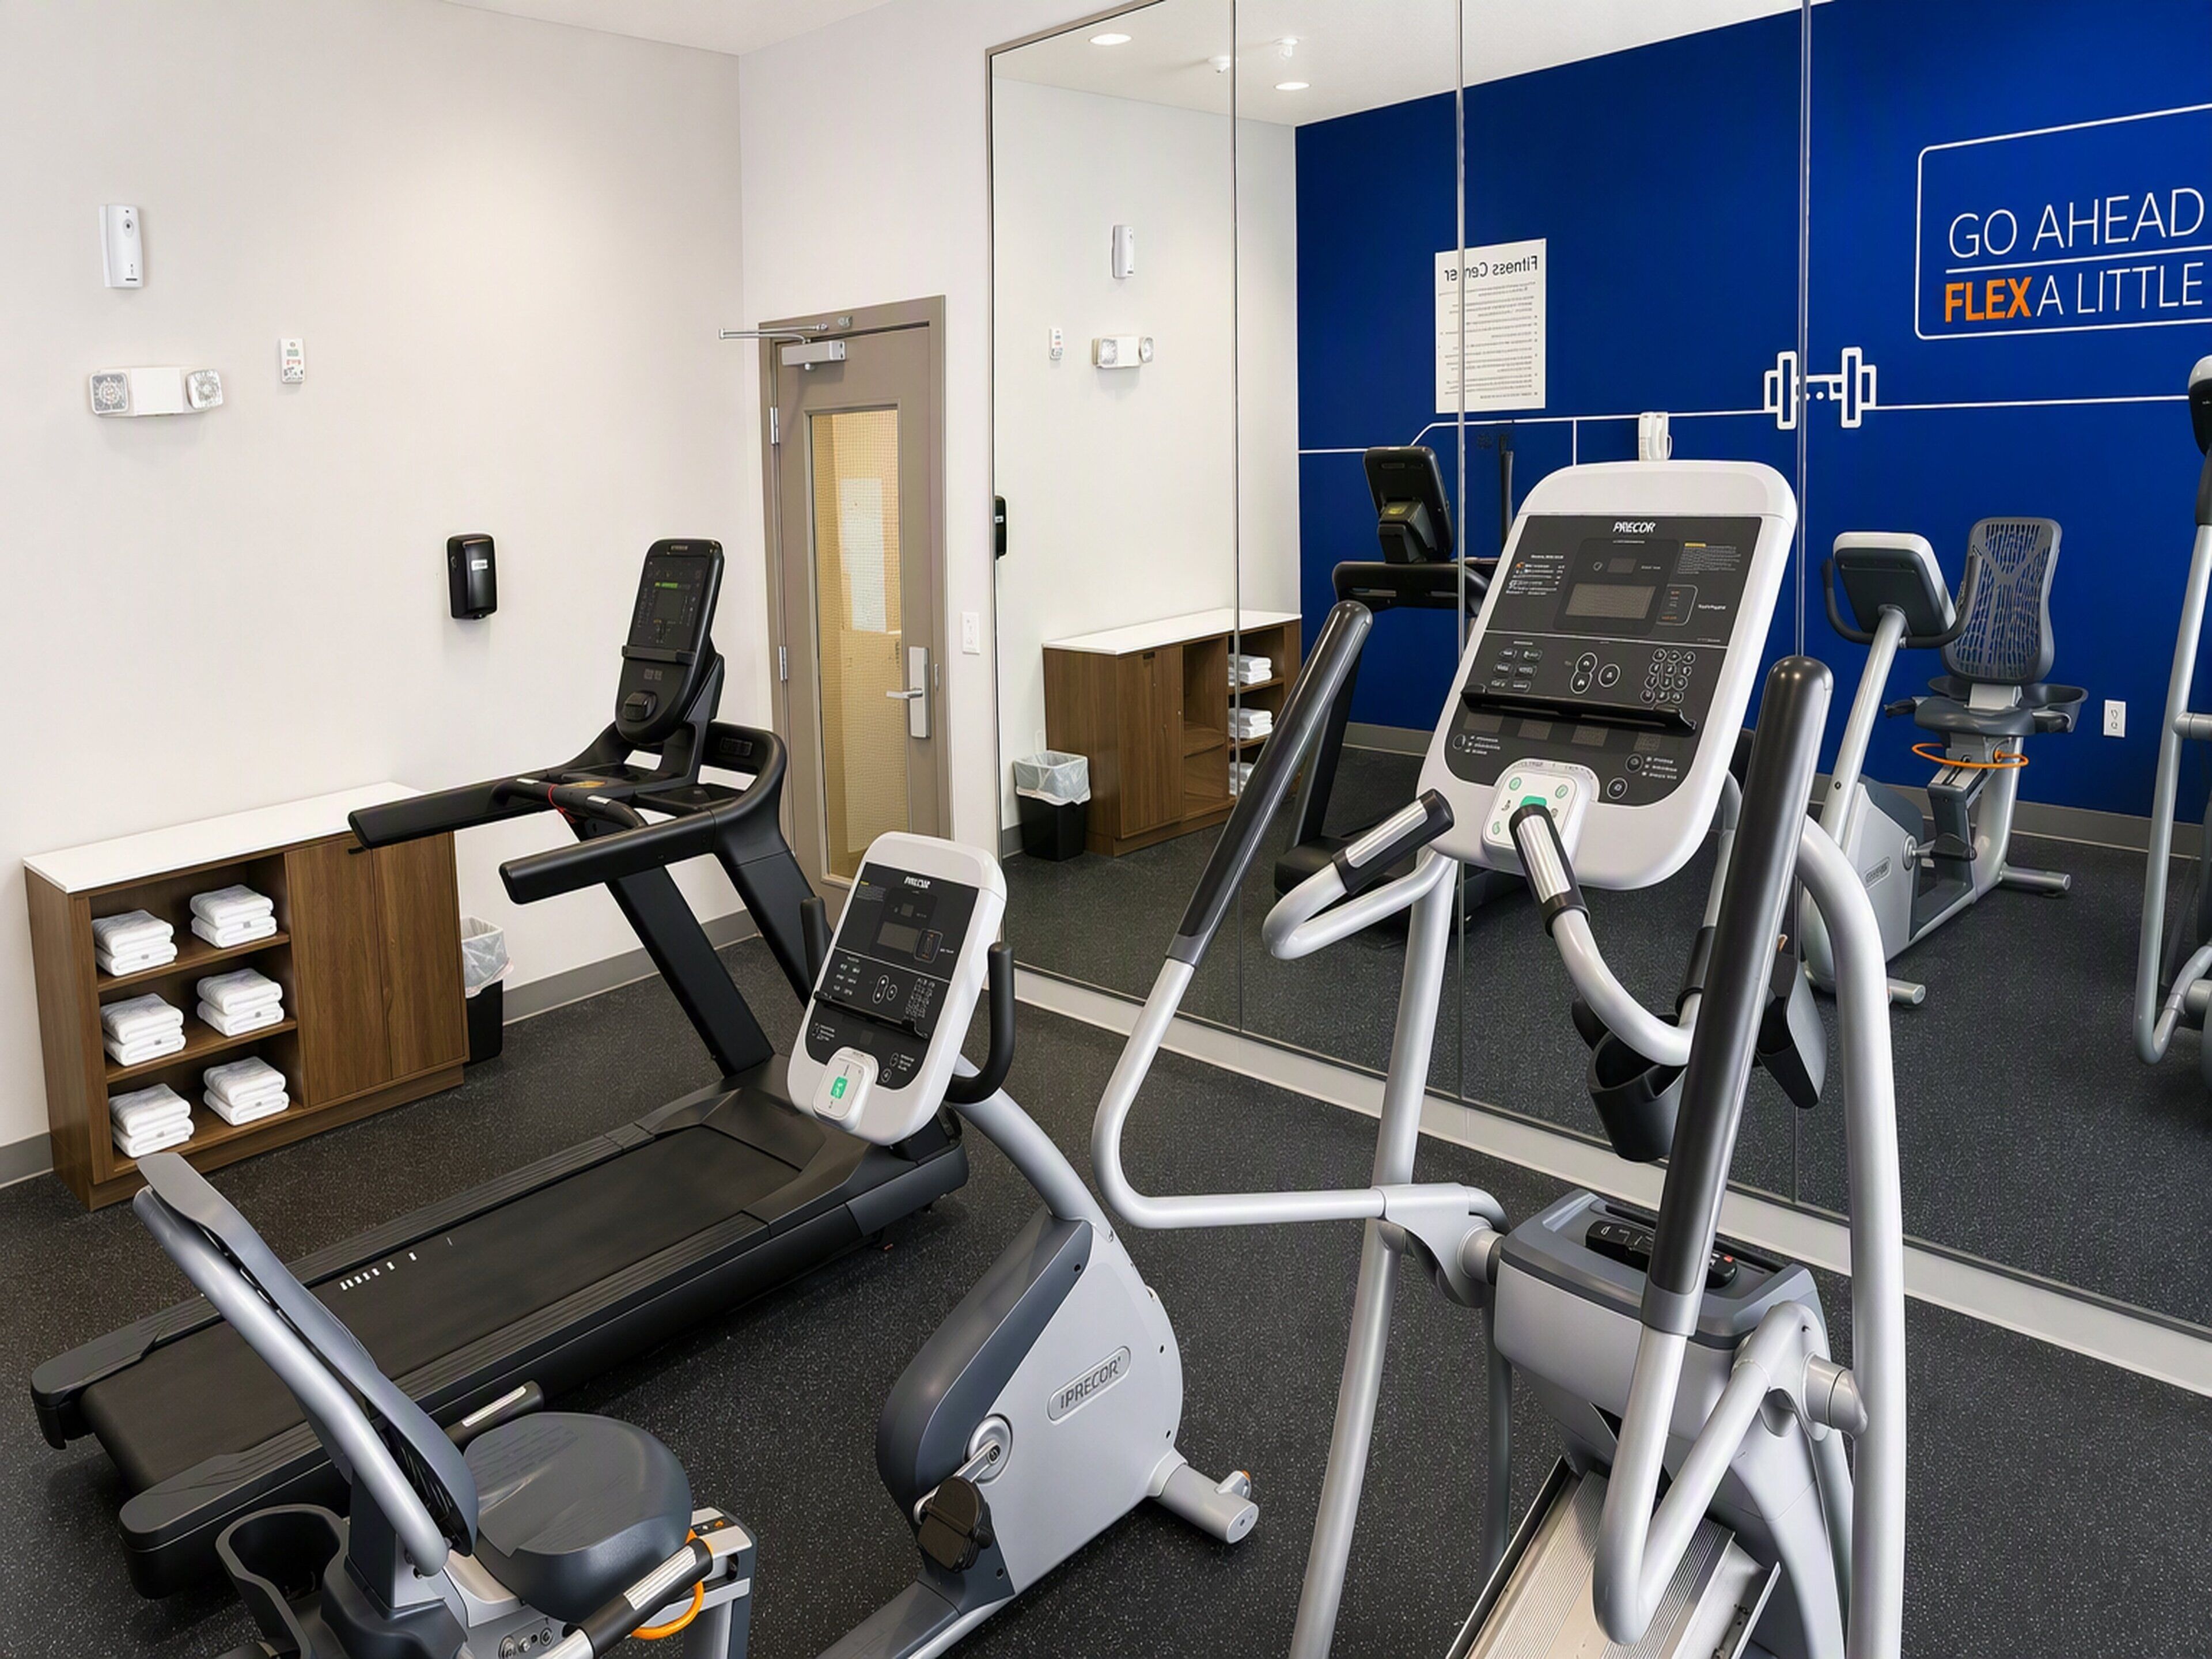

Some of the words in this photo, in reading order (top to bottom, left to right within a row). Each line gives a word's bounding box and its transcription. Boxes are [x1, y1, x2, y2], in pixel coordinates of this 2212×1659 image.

[1948, 209, 2018, 259] GO
[2032, 188, 2205, 251] AHEAD
[1945, 276, 2033, 323] FLEX
[2037, 275, 2064, 317] A
[2077, 262, 2205, 314] LITTLE
